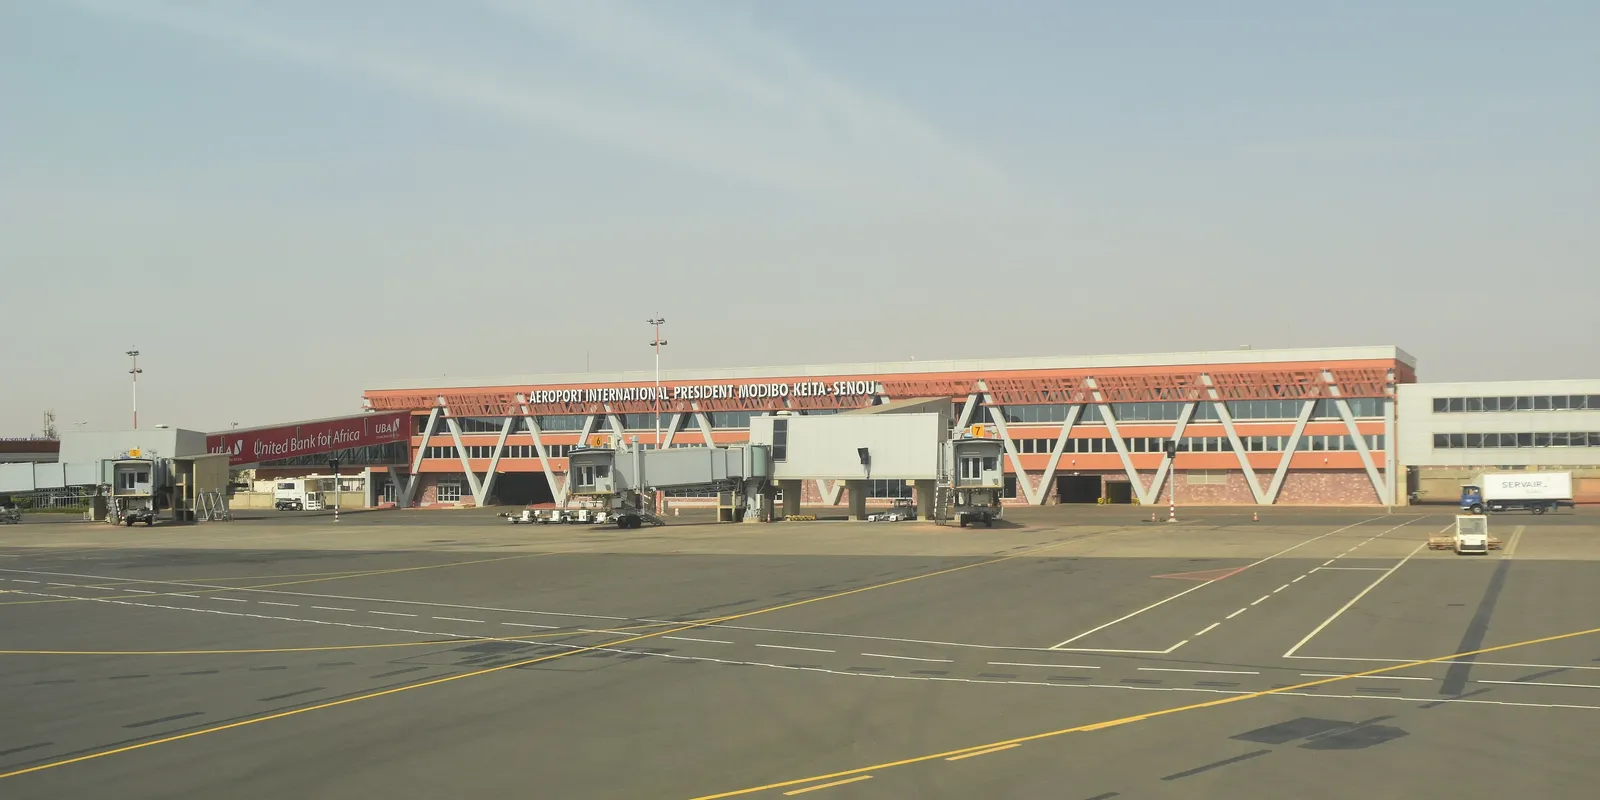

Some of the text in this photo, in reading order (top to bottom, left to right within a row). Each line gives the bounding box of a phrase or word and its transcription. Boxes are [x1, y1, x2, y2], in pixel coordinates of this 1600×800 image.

[529, 389, 582, 403] AEROPORT
[586, 386, 669, 402] INTERNATIONAL
[674, 384, 733, 400] PRESIDENT
[739, 382, 789, 398] MODIBO
[376, 423, 391, 433] UBA
[975, 426, 981, 435] 7
[253, 429, 360, 455] United Bank for Africa
[596, 437, 601, 446] 6
[1502, 481, 1542, 489] SERVAIR
